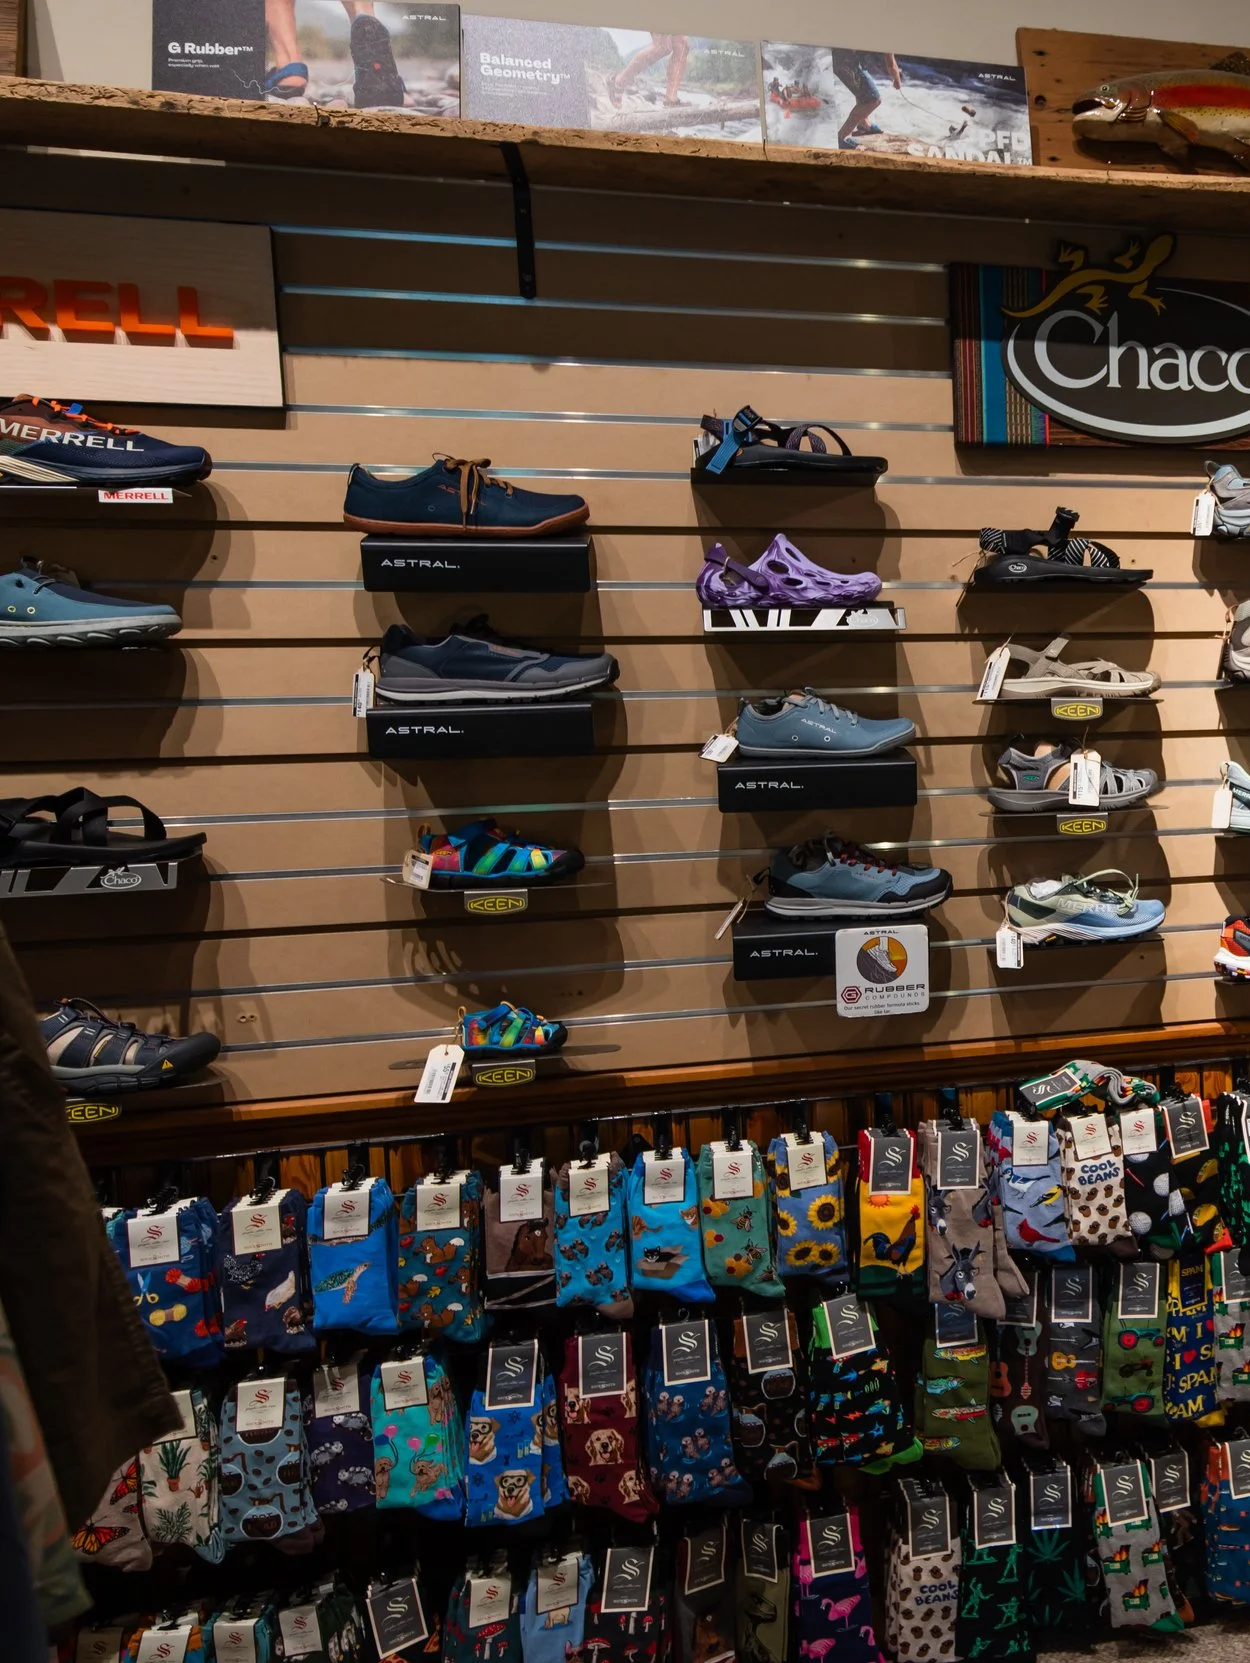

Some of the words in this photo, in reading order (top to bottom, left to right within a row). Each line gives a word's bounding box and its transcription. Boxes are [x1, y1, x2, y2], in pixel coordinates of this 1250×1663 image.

[168, 41, 181, 54] G
[479, 52, 552, 69] Balanced
[978, 73, 1017, 81] ASTRAL
[103, 491, 169, 501] MERRELL
[380, 559, 458, 569] ASTRAL
[1055, 705, 1100, 717] KEEN
[385, 726, 461, 735] ASTRAL
[800, 717, 837, 734] ASTRAL
[734, 781, 802, 790] ASTRAL
[1061, 821, 1106, 833] KEEN
[104, 874, 140, 886] Chaco
[470, 897, 524, 910] KEEN
[1057, 898, 1118, 914] MERRE
[749, 948, 815, 958] ASTRAL
[864, 984, 926, 994] RUBBER
[865, 992, 925, 1001] COMPOUNDS
[478, 1068, 532, 1083] KEEN
[1080, 1159, 1117, 1174] COOL
[1077, 1167, 1121, 1186] BEANS
[1181, 1264, 1204, 1278] SPAM
[919, 1581, 957, 1595] COOL
